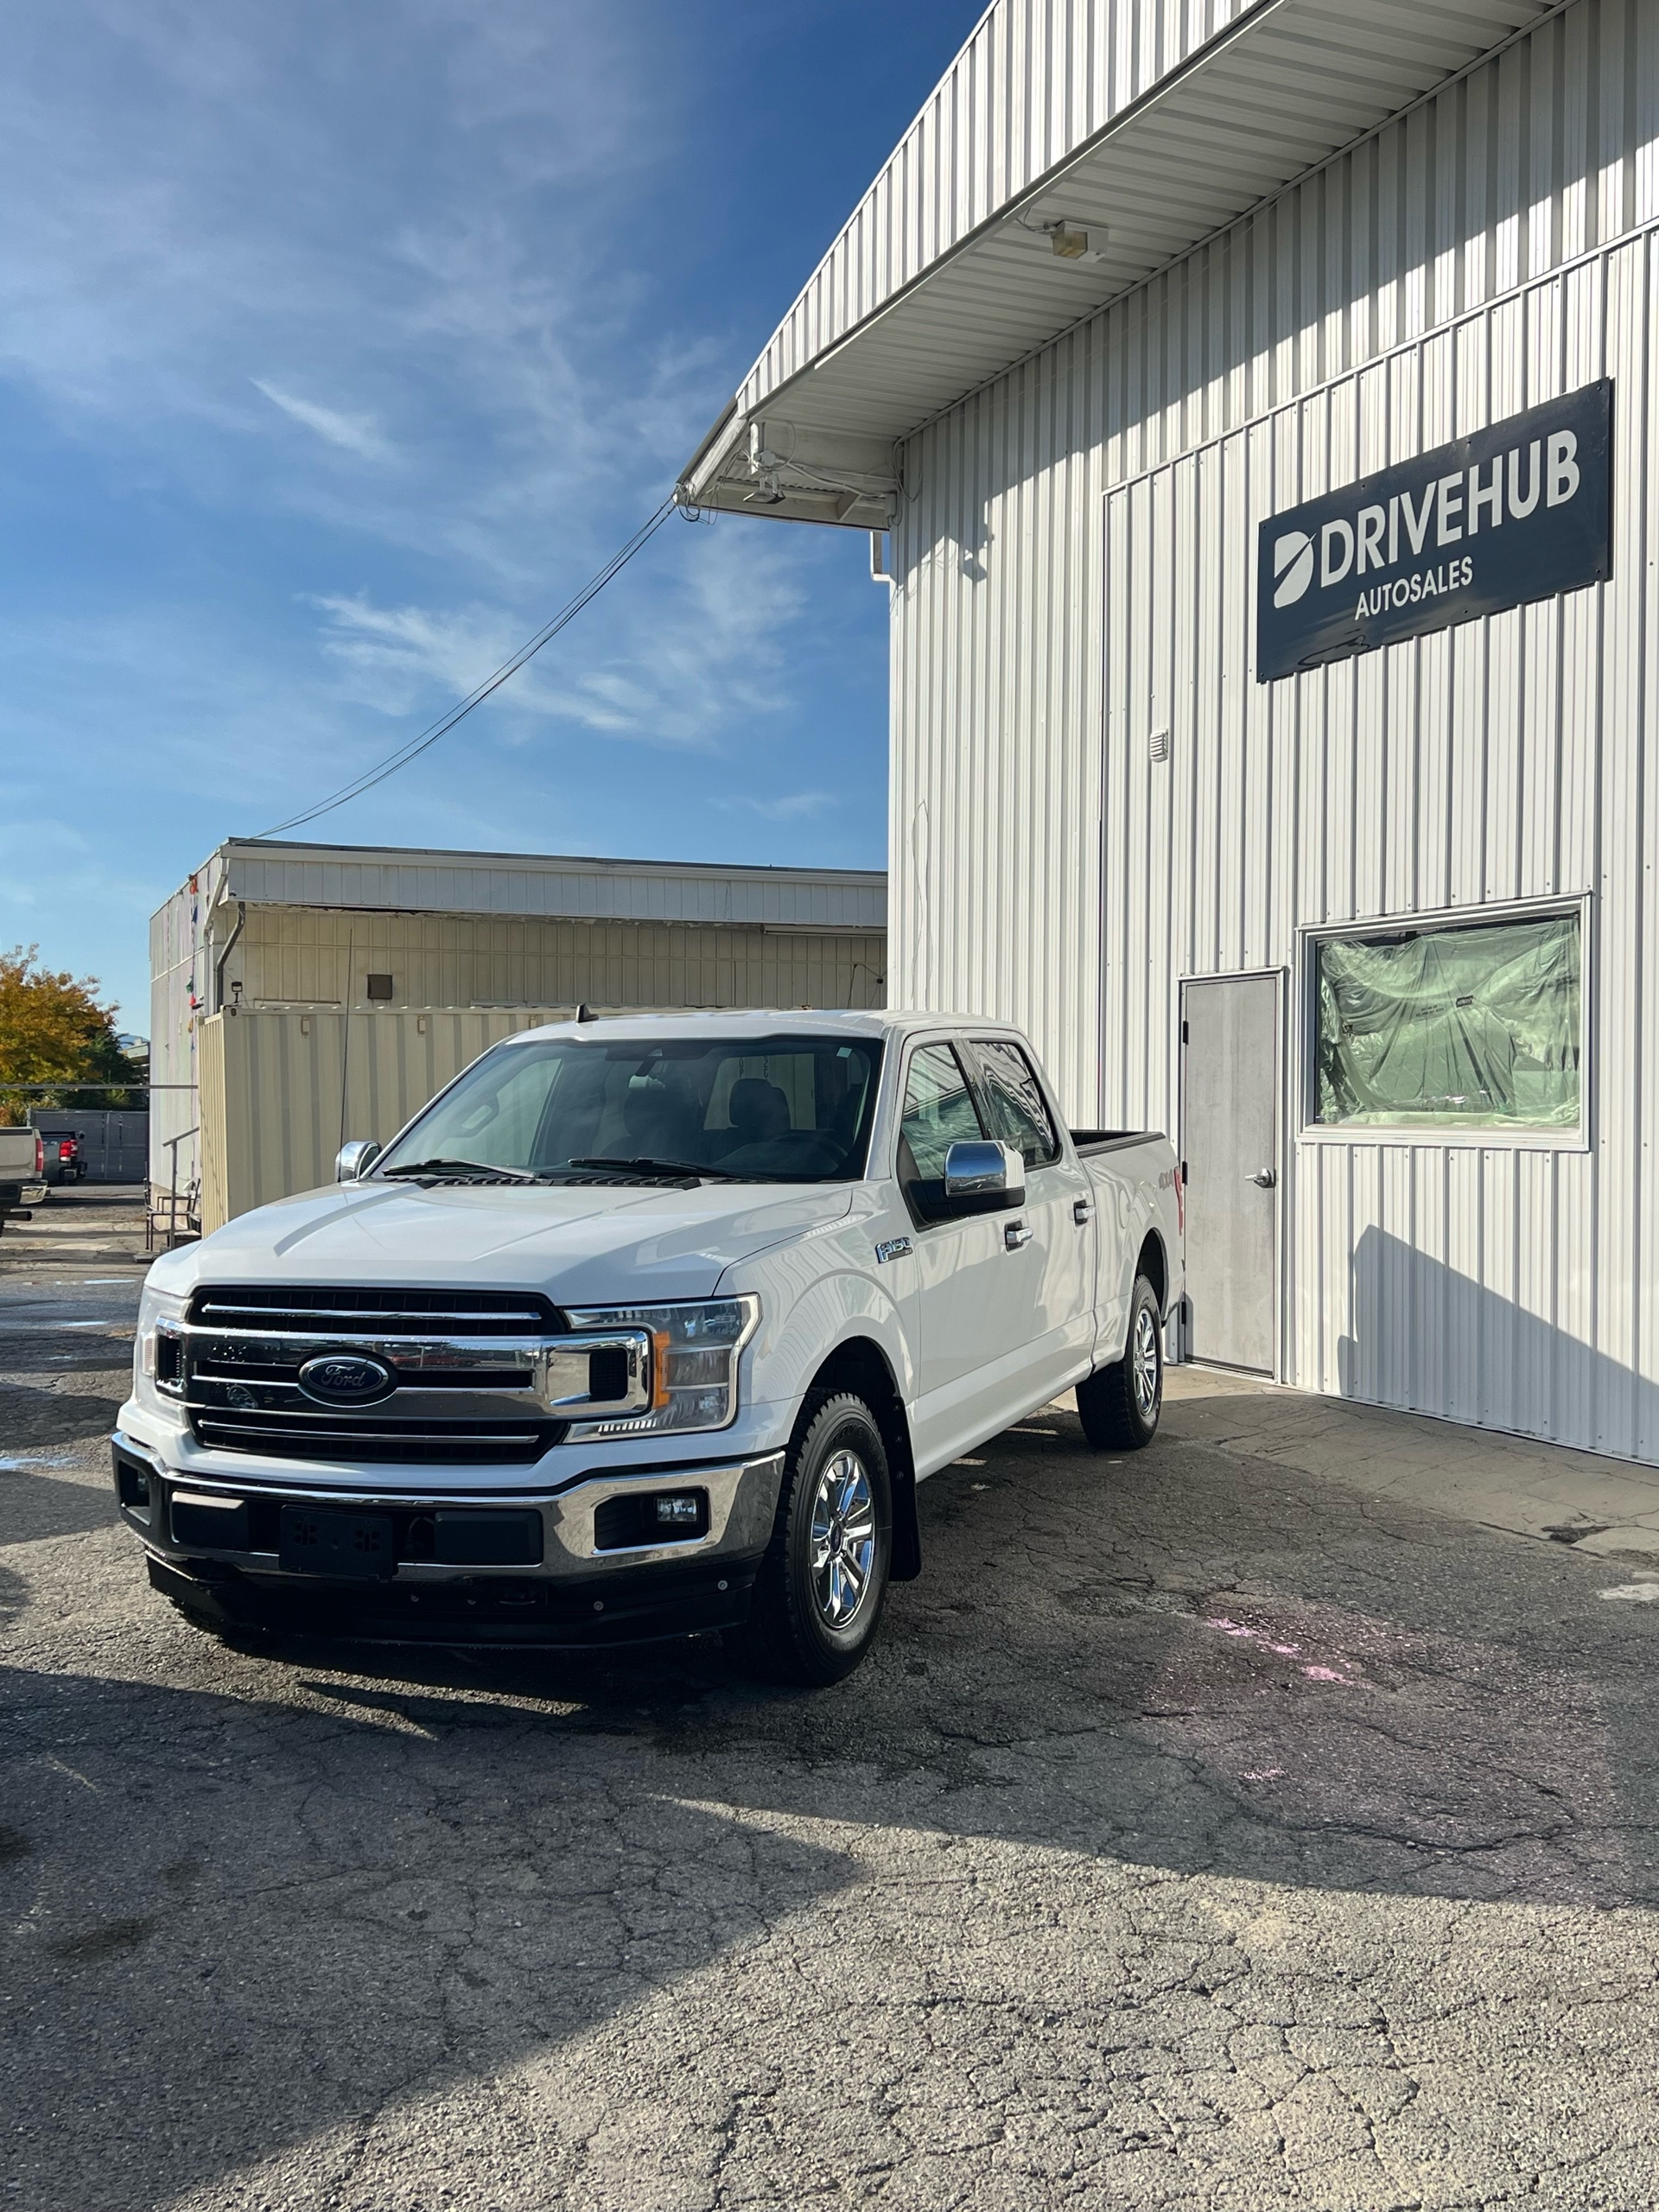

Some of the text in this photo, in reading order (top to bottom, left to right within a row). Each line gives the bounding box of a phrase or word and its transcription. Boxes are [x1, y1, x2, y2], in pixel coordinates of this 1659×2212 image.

[1320, 429, 1580, 588] DRIVEHUB
[1354, 555, 1473, 621] AUTOSALES
[321, 1364, 366, 1387] Ford
